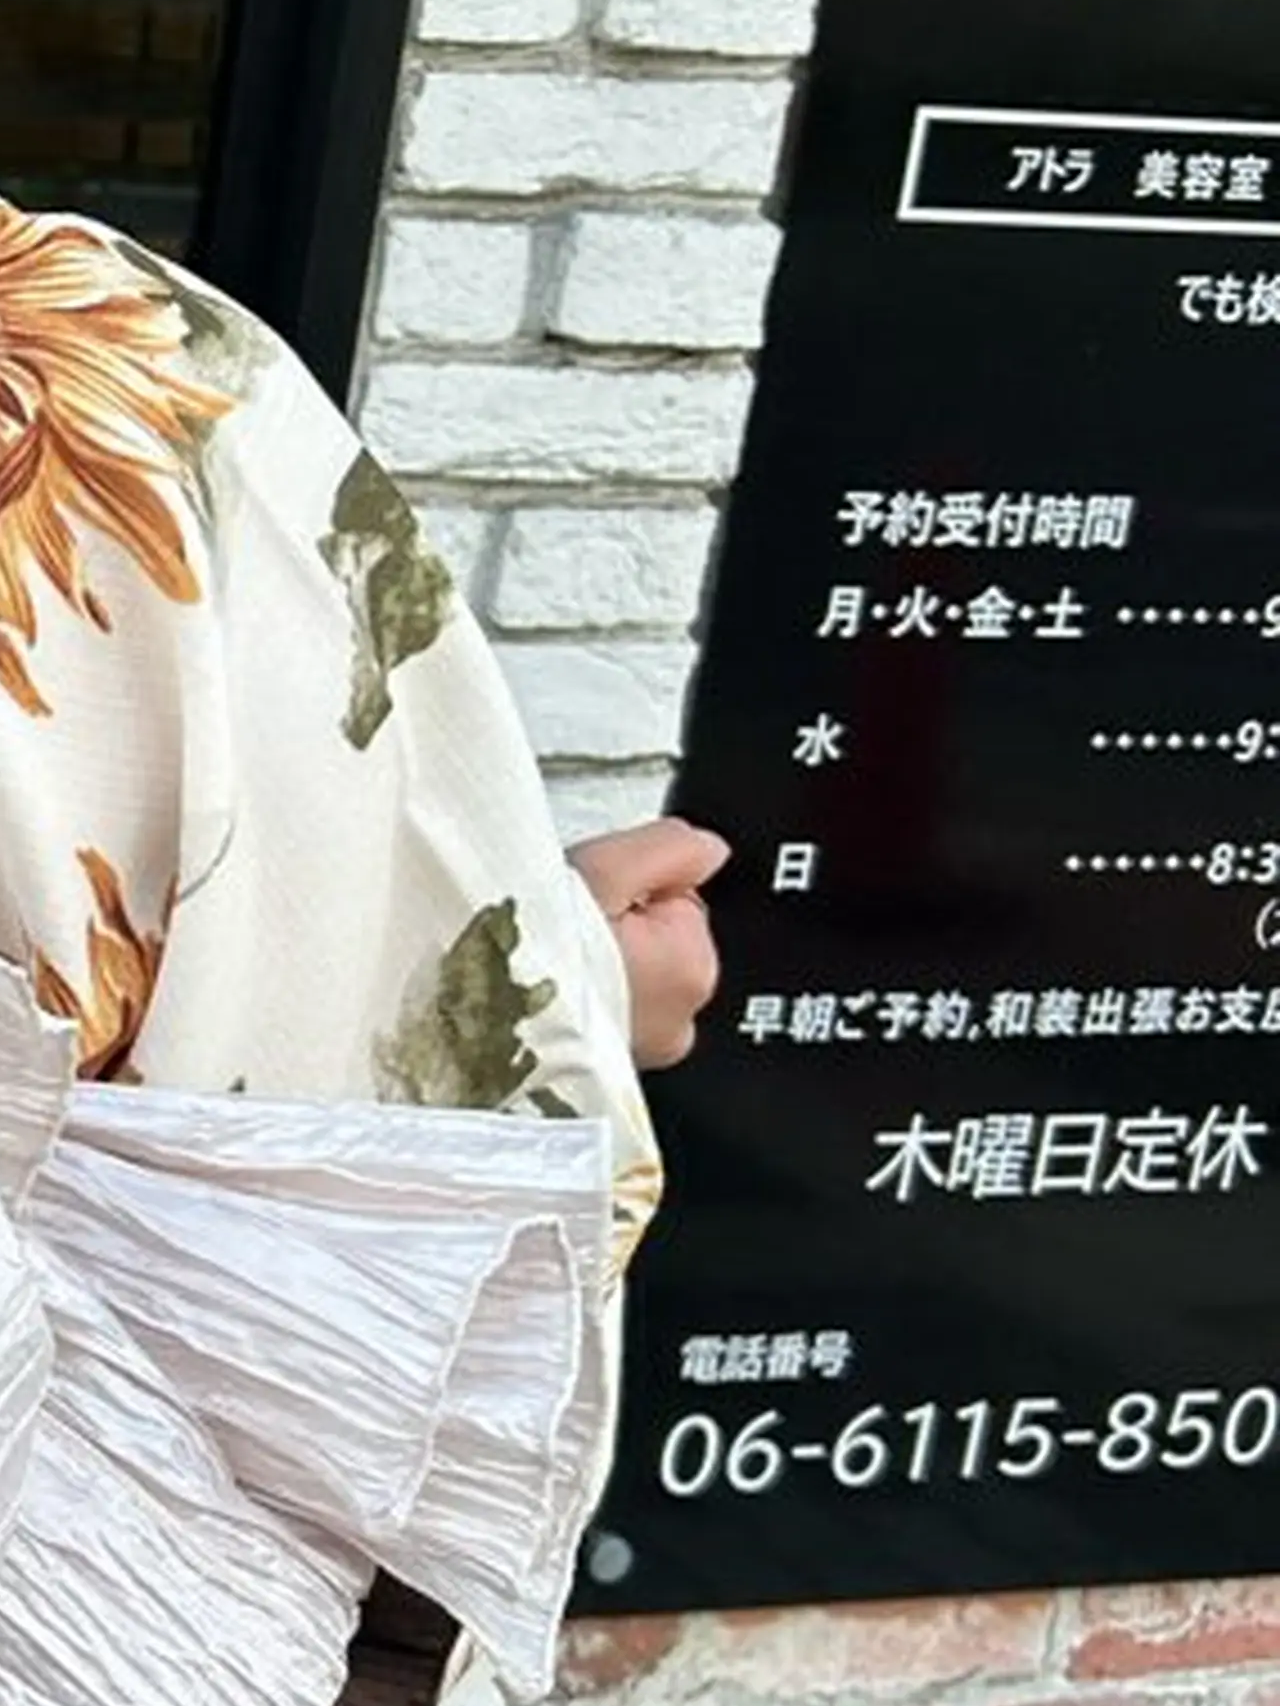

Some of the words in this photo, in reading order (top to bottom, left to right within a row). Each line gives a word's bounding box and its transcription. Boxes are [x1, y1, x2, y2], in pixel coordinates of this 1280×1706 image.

[1006, 146, 1095, 193] アトラ
[1133, 149, 1271, 201] 美容室
[837, 490, 1134, 549] 予約受付時間
[792, 713, 844, 766] 水
[772, 842, 817, 891] 日
[865, 1103, 1269, 1202] 木曜日定休
[680, 1330, 852, 1383] 電話番号
[660, 1385, 1279, 1496] 06-6115-850
